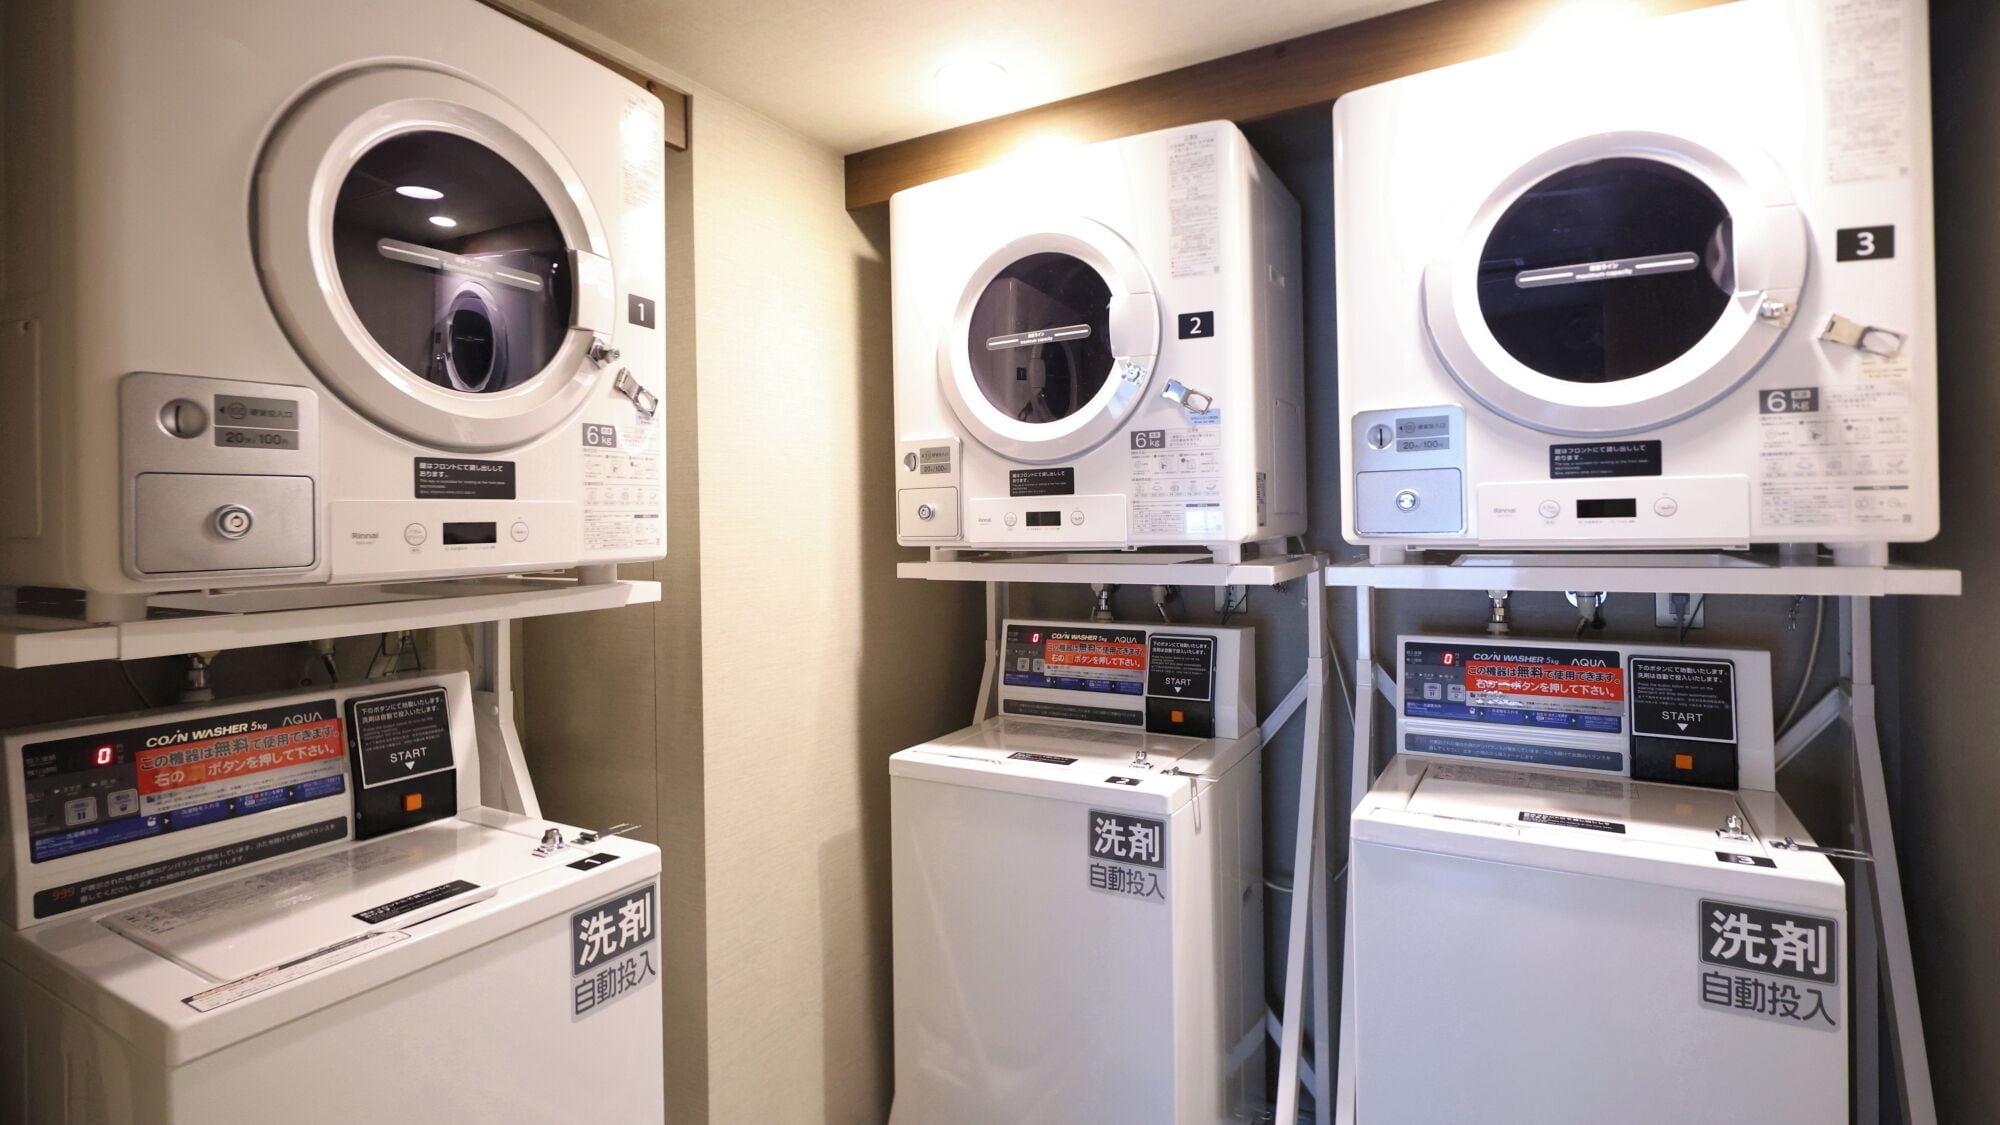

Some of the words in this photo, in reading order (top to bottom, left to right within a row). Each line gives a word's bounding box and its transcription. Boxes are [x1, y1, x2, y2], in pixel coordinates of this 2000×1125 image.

[1856, 232, 1875, 256] 3
[637, 302, 645, 322] 1
[1190, 317, 1202, 335] 2
[1767, 391, 1786, 412] 6
[587, 426, 599, 445] 6
[1135, 432, 1147, 448] 6
[1032, 633, 1039, 643] 0
[1071, 633, 1098, 641] WASHER
[1114, 636, 1137, 644] AQUA
[1443, 653, 1453, 665] 0
[1503, 654, 1544, 664] WASHER
[1545, 657, 1560, 666] 5kg
[1571, 658, 1607, 668] AQUA
[1165, 677, 1192, 686] START
[1467, 665, 1621, 685] この機器は無料で使用できます。
[282, 711, 323, 727] AQUA
[1661, 711, 1703, 723] START
[146, 729, 188, 749] COIN
[192, 723, 248, 741] WASHER
[250, 721, 268, 732] 5kg
[97, 747, 112, 764] 0
[140, 725, 342, 771] この機器は無料で使用できます。
[390, 746, 427, 763] START
[154, 771, 185, 788] 右の
[207, 743, 336, 777] ボタンを押して下さい。
[1094, 816, 1160, 863] 洗剤
[1736, 855, 1755, 865] 3
[1090, 863, 1165, 900] 自動投入
[578, 892, 652, 967] 洗剤
[1709, 910, 1828, 975] 洗剤
[575, 950, 657, 1016] 自動投入
[1703, 971, 1836, 1026] 自動投入
